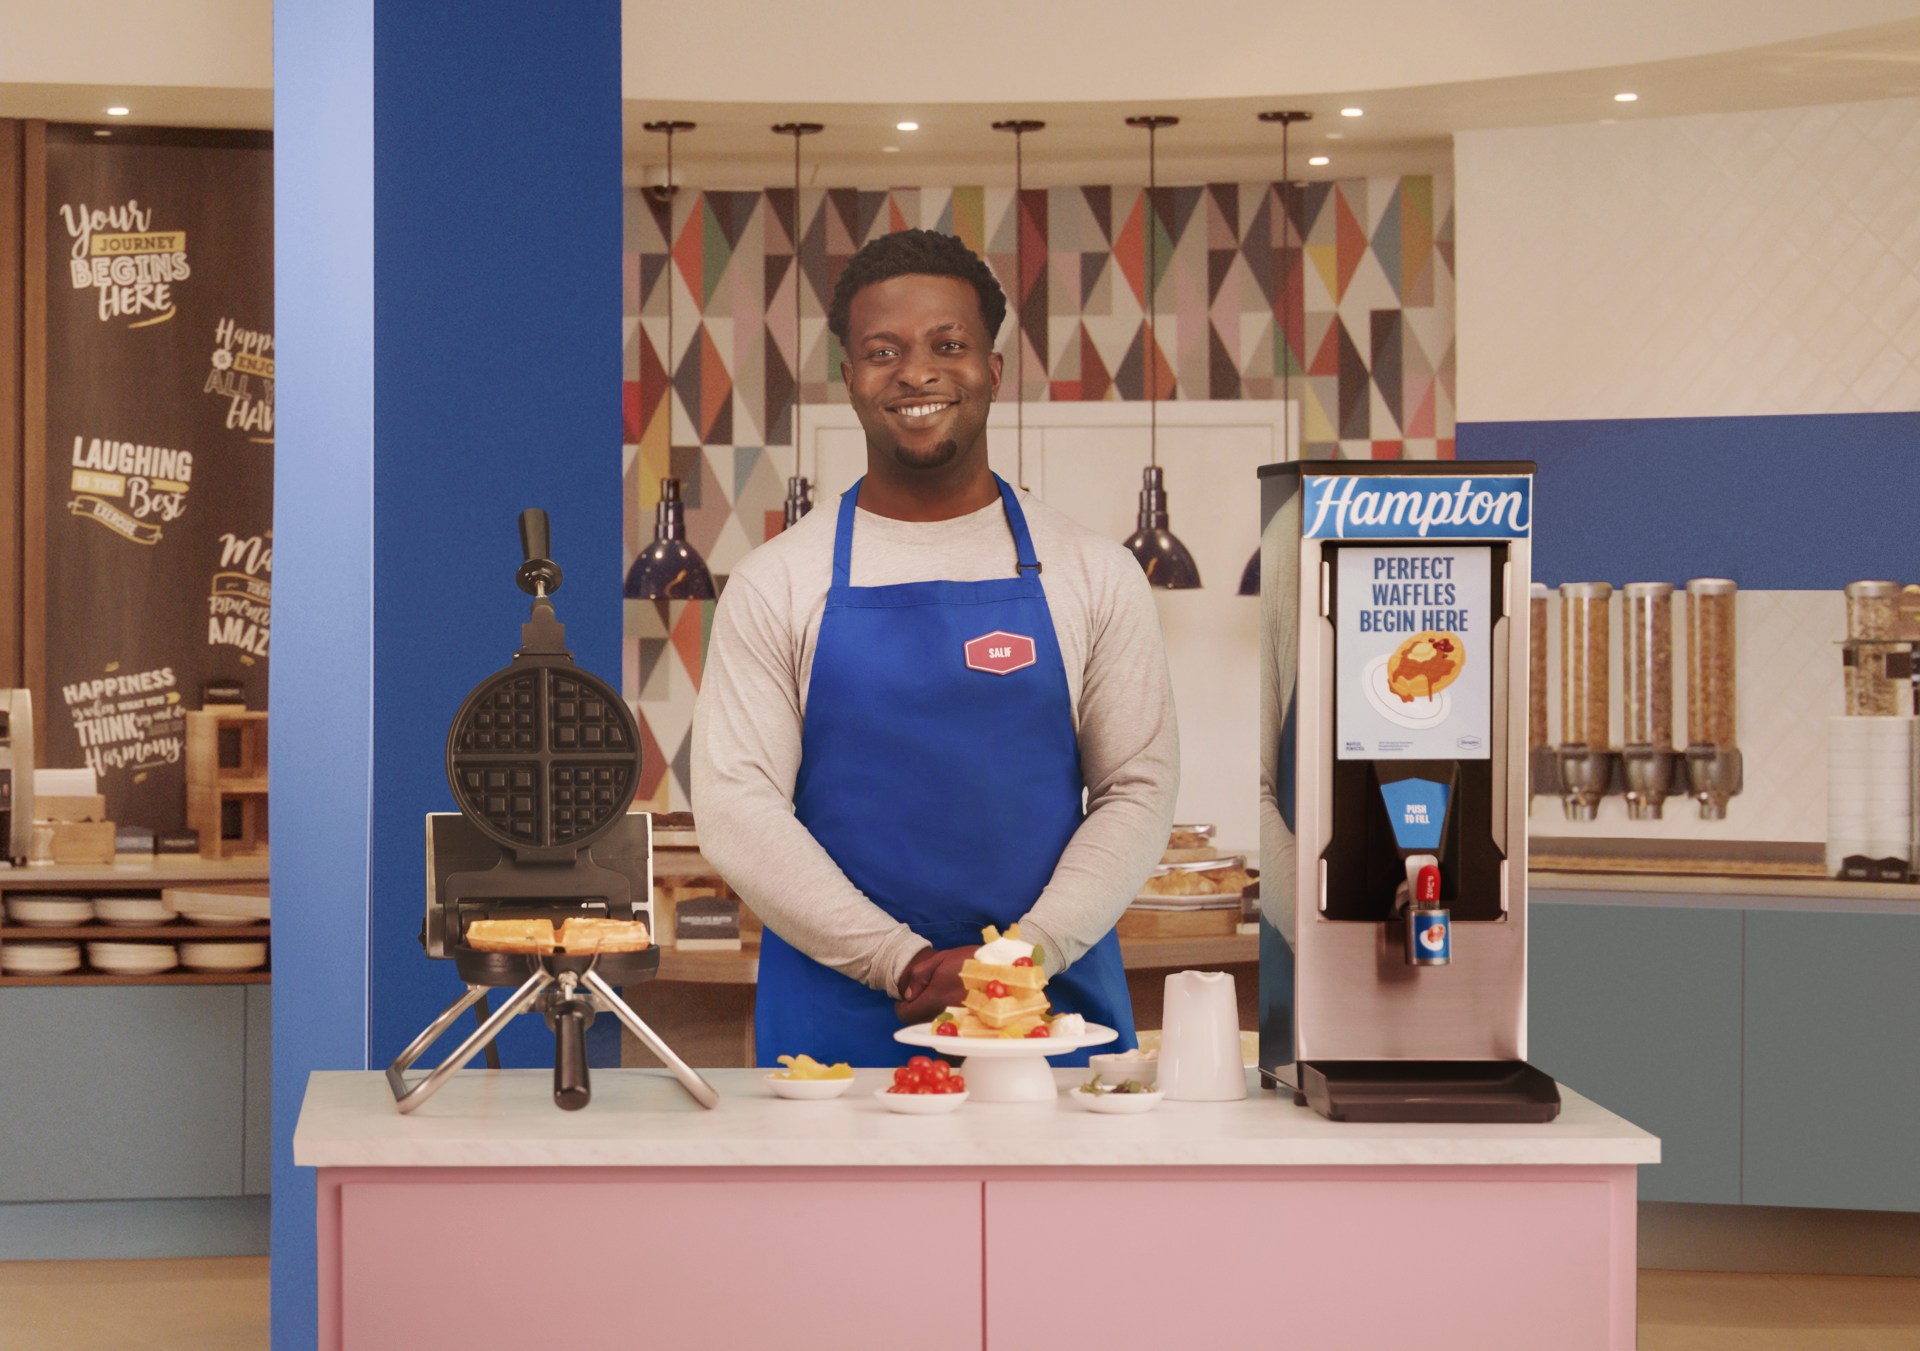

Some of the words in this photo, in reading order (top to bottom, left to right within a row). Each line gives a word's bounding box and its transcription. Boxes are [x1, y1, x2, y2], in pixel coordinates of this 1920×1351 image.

[59, 199, 152, 260] Your
[100, 236, 176, 252] JOURNEY
[70, 252, 191, 289] BEGINS
[98, 283, 171, 321] HERE
[214, 317, 274, 357] Happ
[203, 368, 252, 400] ALL
[238, 356, 274, 375] ENJO
[226, 395, 274, 432] HAV
[72, 435, 193, 481] LAUGHING
[127, 477, 187, 522] Best
[1303, 477, 1529, 538] Hampton
[219, 533, 272, 575] Ma
[1374, 557, 1455, 580] PERFECT
[1372, 583, 1456, 606] WAFFLES
[208, 616, 269, 657] AMAZ
[1360, 609, 1415, 632] BEGIN
[1422, 609, 1468, 632] HERE
[988, 647, 1012, 659] SALIF
[62, 667, 176, 704] HAPPINESS
[74, 712, 145, 747] THINK,
[84, 736, 184, 777] Harmony
[1405, 814, 1415, 824] TO
[1416, 814, 1430, 824] FILL
[1406, 804, 1427, 814] PUSH
